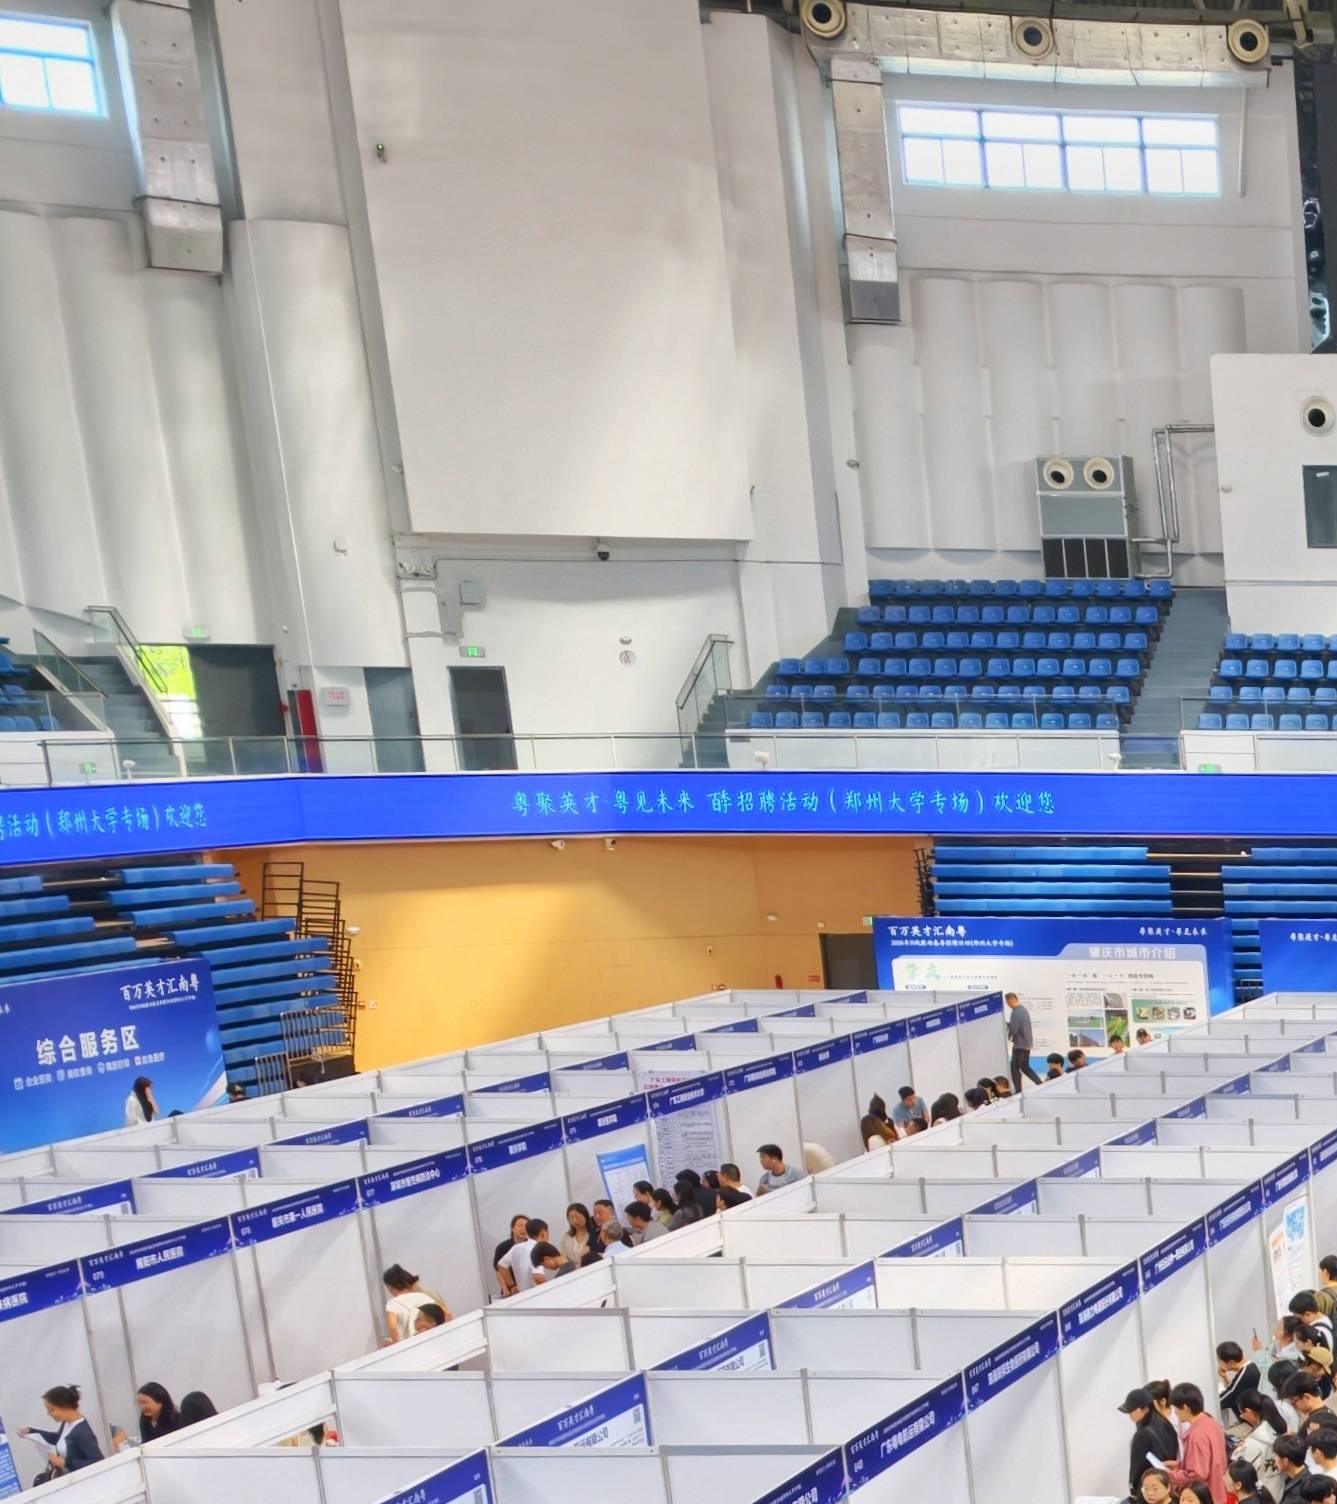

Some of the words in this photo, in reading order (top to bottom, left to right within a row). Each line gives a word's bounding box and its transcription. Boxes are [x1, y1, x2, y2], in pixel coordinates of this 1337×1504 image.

[119, 972, 200, 1002] 百万英才汇南粤
[35, 1025, 140, 1067] 综合服务区
